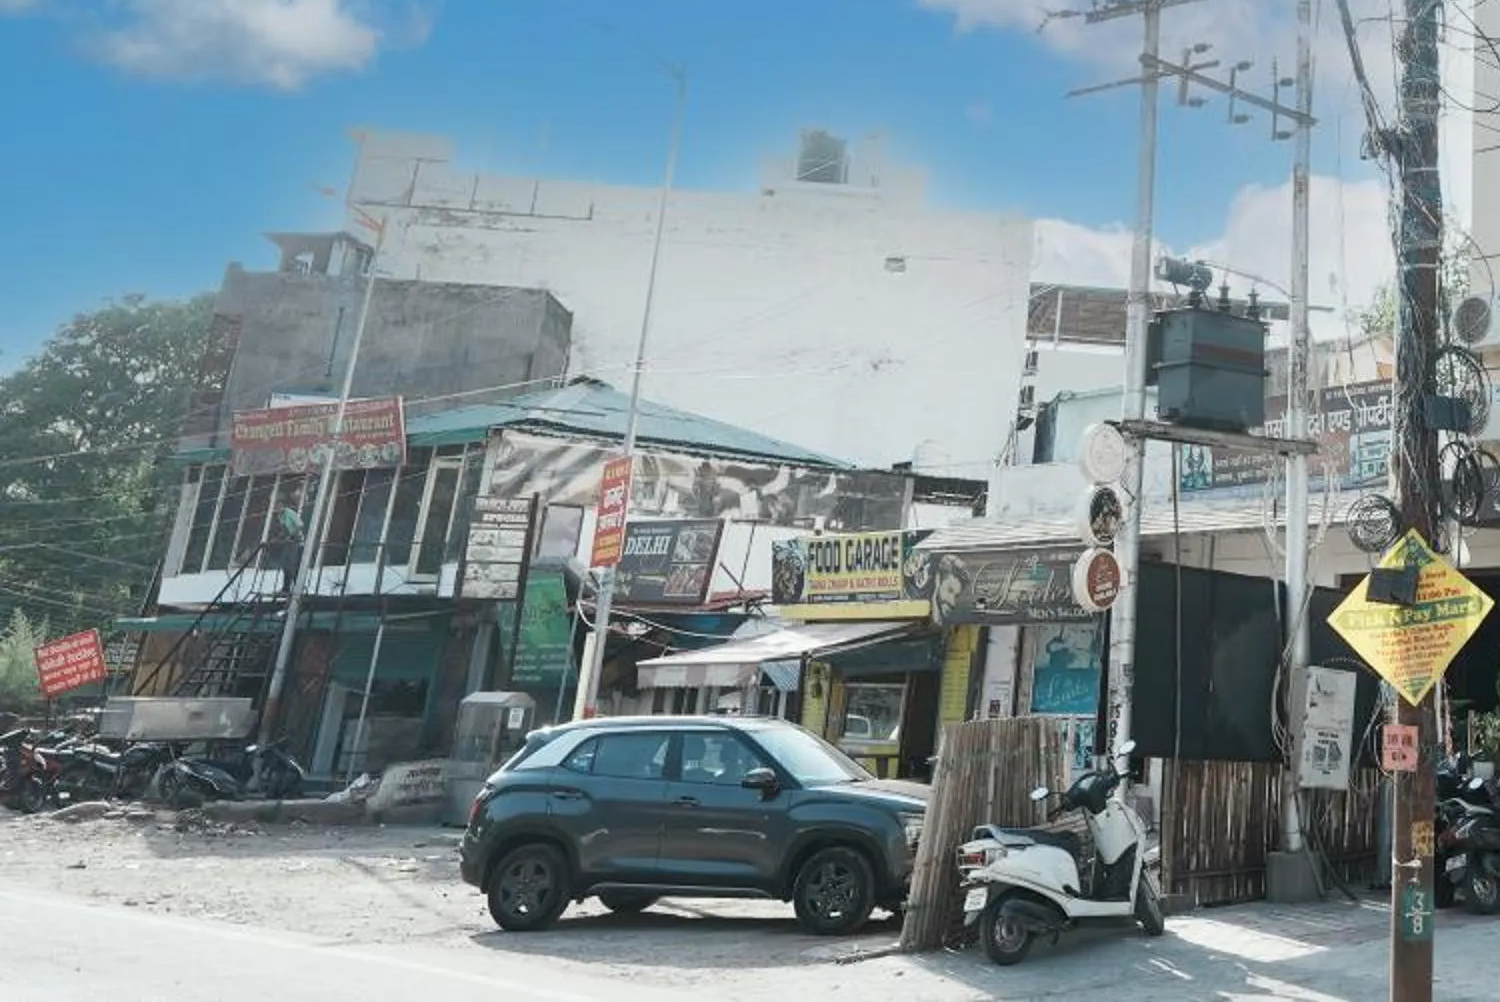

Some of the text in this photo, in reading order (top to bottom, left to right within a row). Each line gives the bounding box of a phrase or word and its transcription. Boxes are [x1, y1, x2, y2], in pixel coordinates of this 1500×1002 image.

[328, 412, 394, 434] Rstaurant
[624, 535, 673, 555] DELHI
[808, 536, 899, 573] FOOD GARAGE
[1403, 607, 1432, 623] Pay
[1436, 598, 1480, 618] Mart
[1412, 892, 1425, 912] 3
